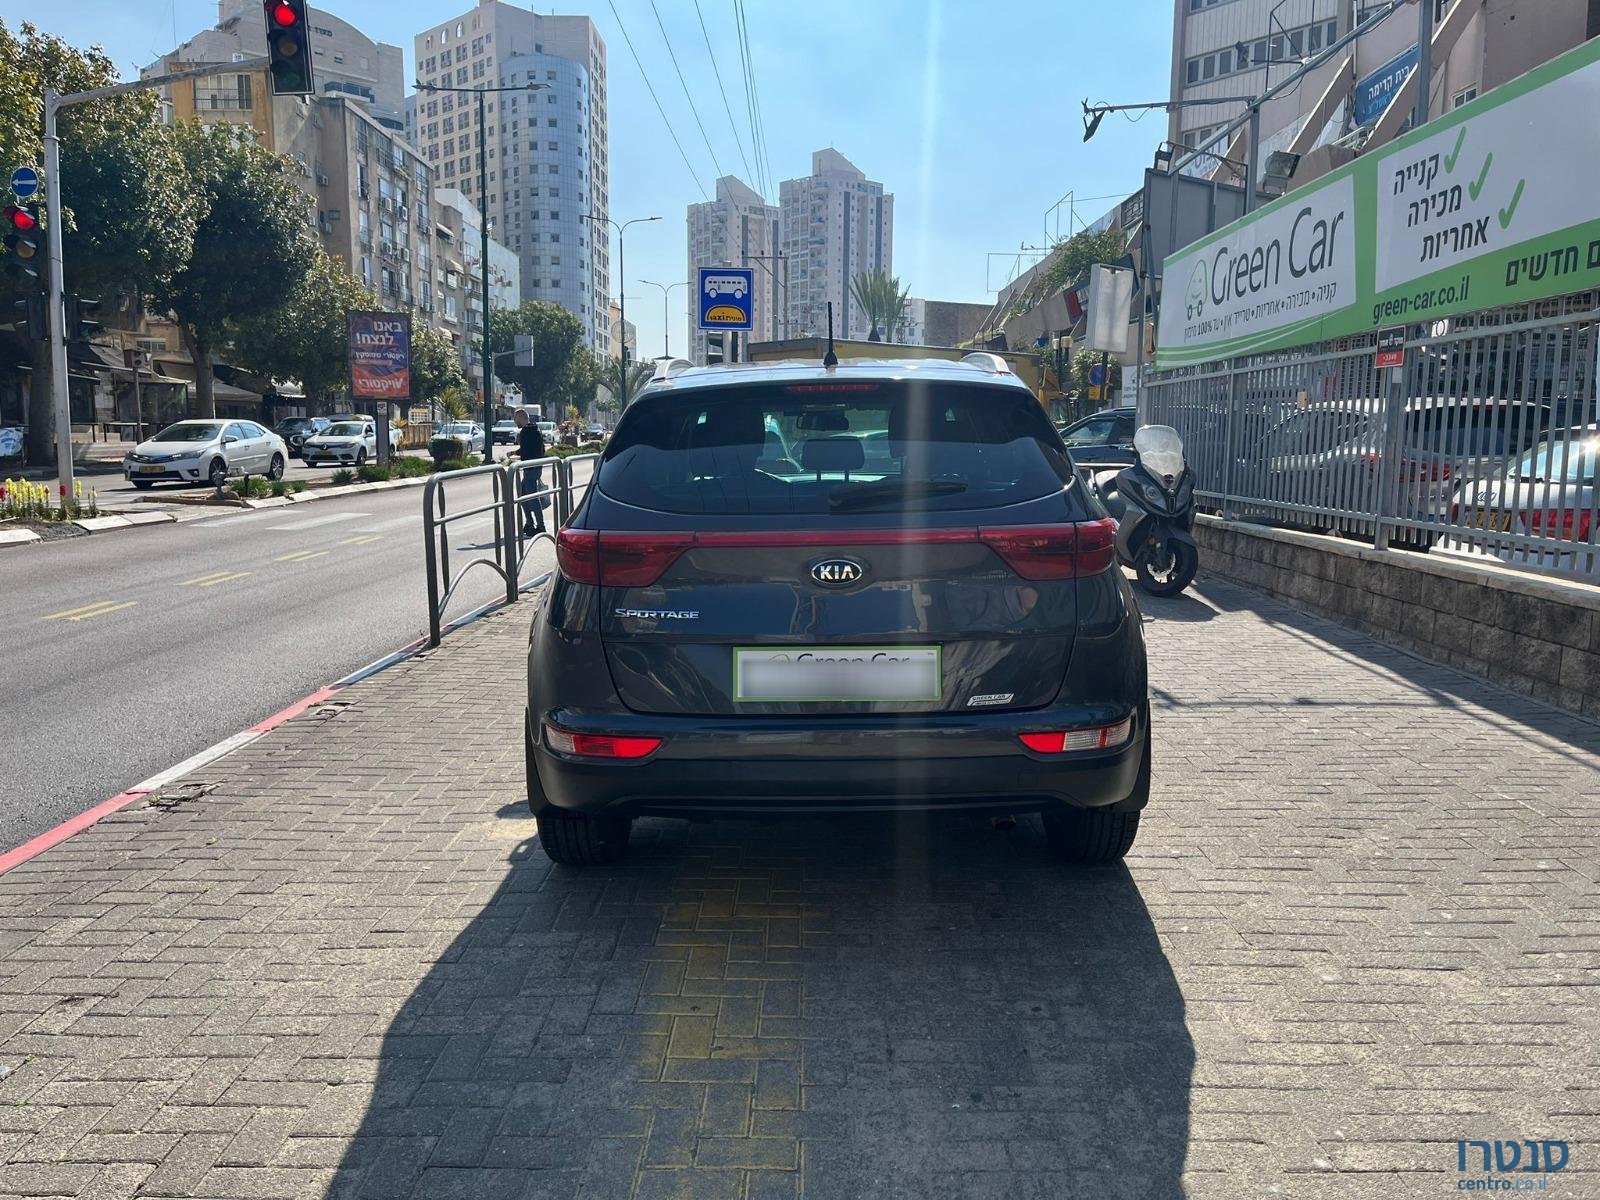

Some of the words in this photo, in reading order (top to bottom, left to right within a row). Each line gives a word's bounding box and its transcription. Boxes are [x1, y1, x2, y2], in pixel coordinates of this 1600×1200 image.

[1368, 75, 1393, 100] קדימה
[1393, 153, 1440, 196] קנייה
[1407, 184, 1462, 227] מכירה
[1420, 216, 1490, 262] אחריות
[1211, 239, 1280, 306] Green
[1288, 207, 1345, 279] Car
[1505, 246, 1579, 287] חדשים
[1372, 275, 1470, 324] green-car.co.il
[356, 333, 394, 345] לנצח!
[373, 321, 403, 332] באנו
[1198, 321, 1213, 335] 100%
[820, 564, 854, 581] KIA
[614, 608, 700, 620] SPORTAGE
